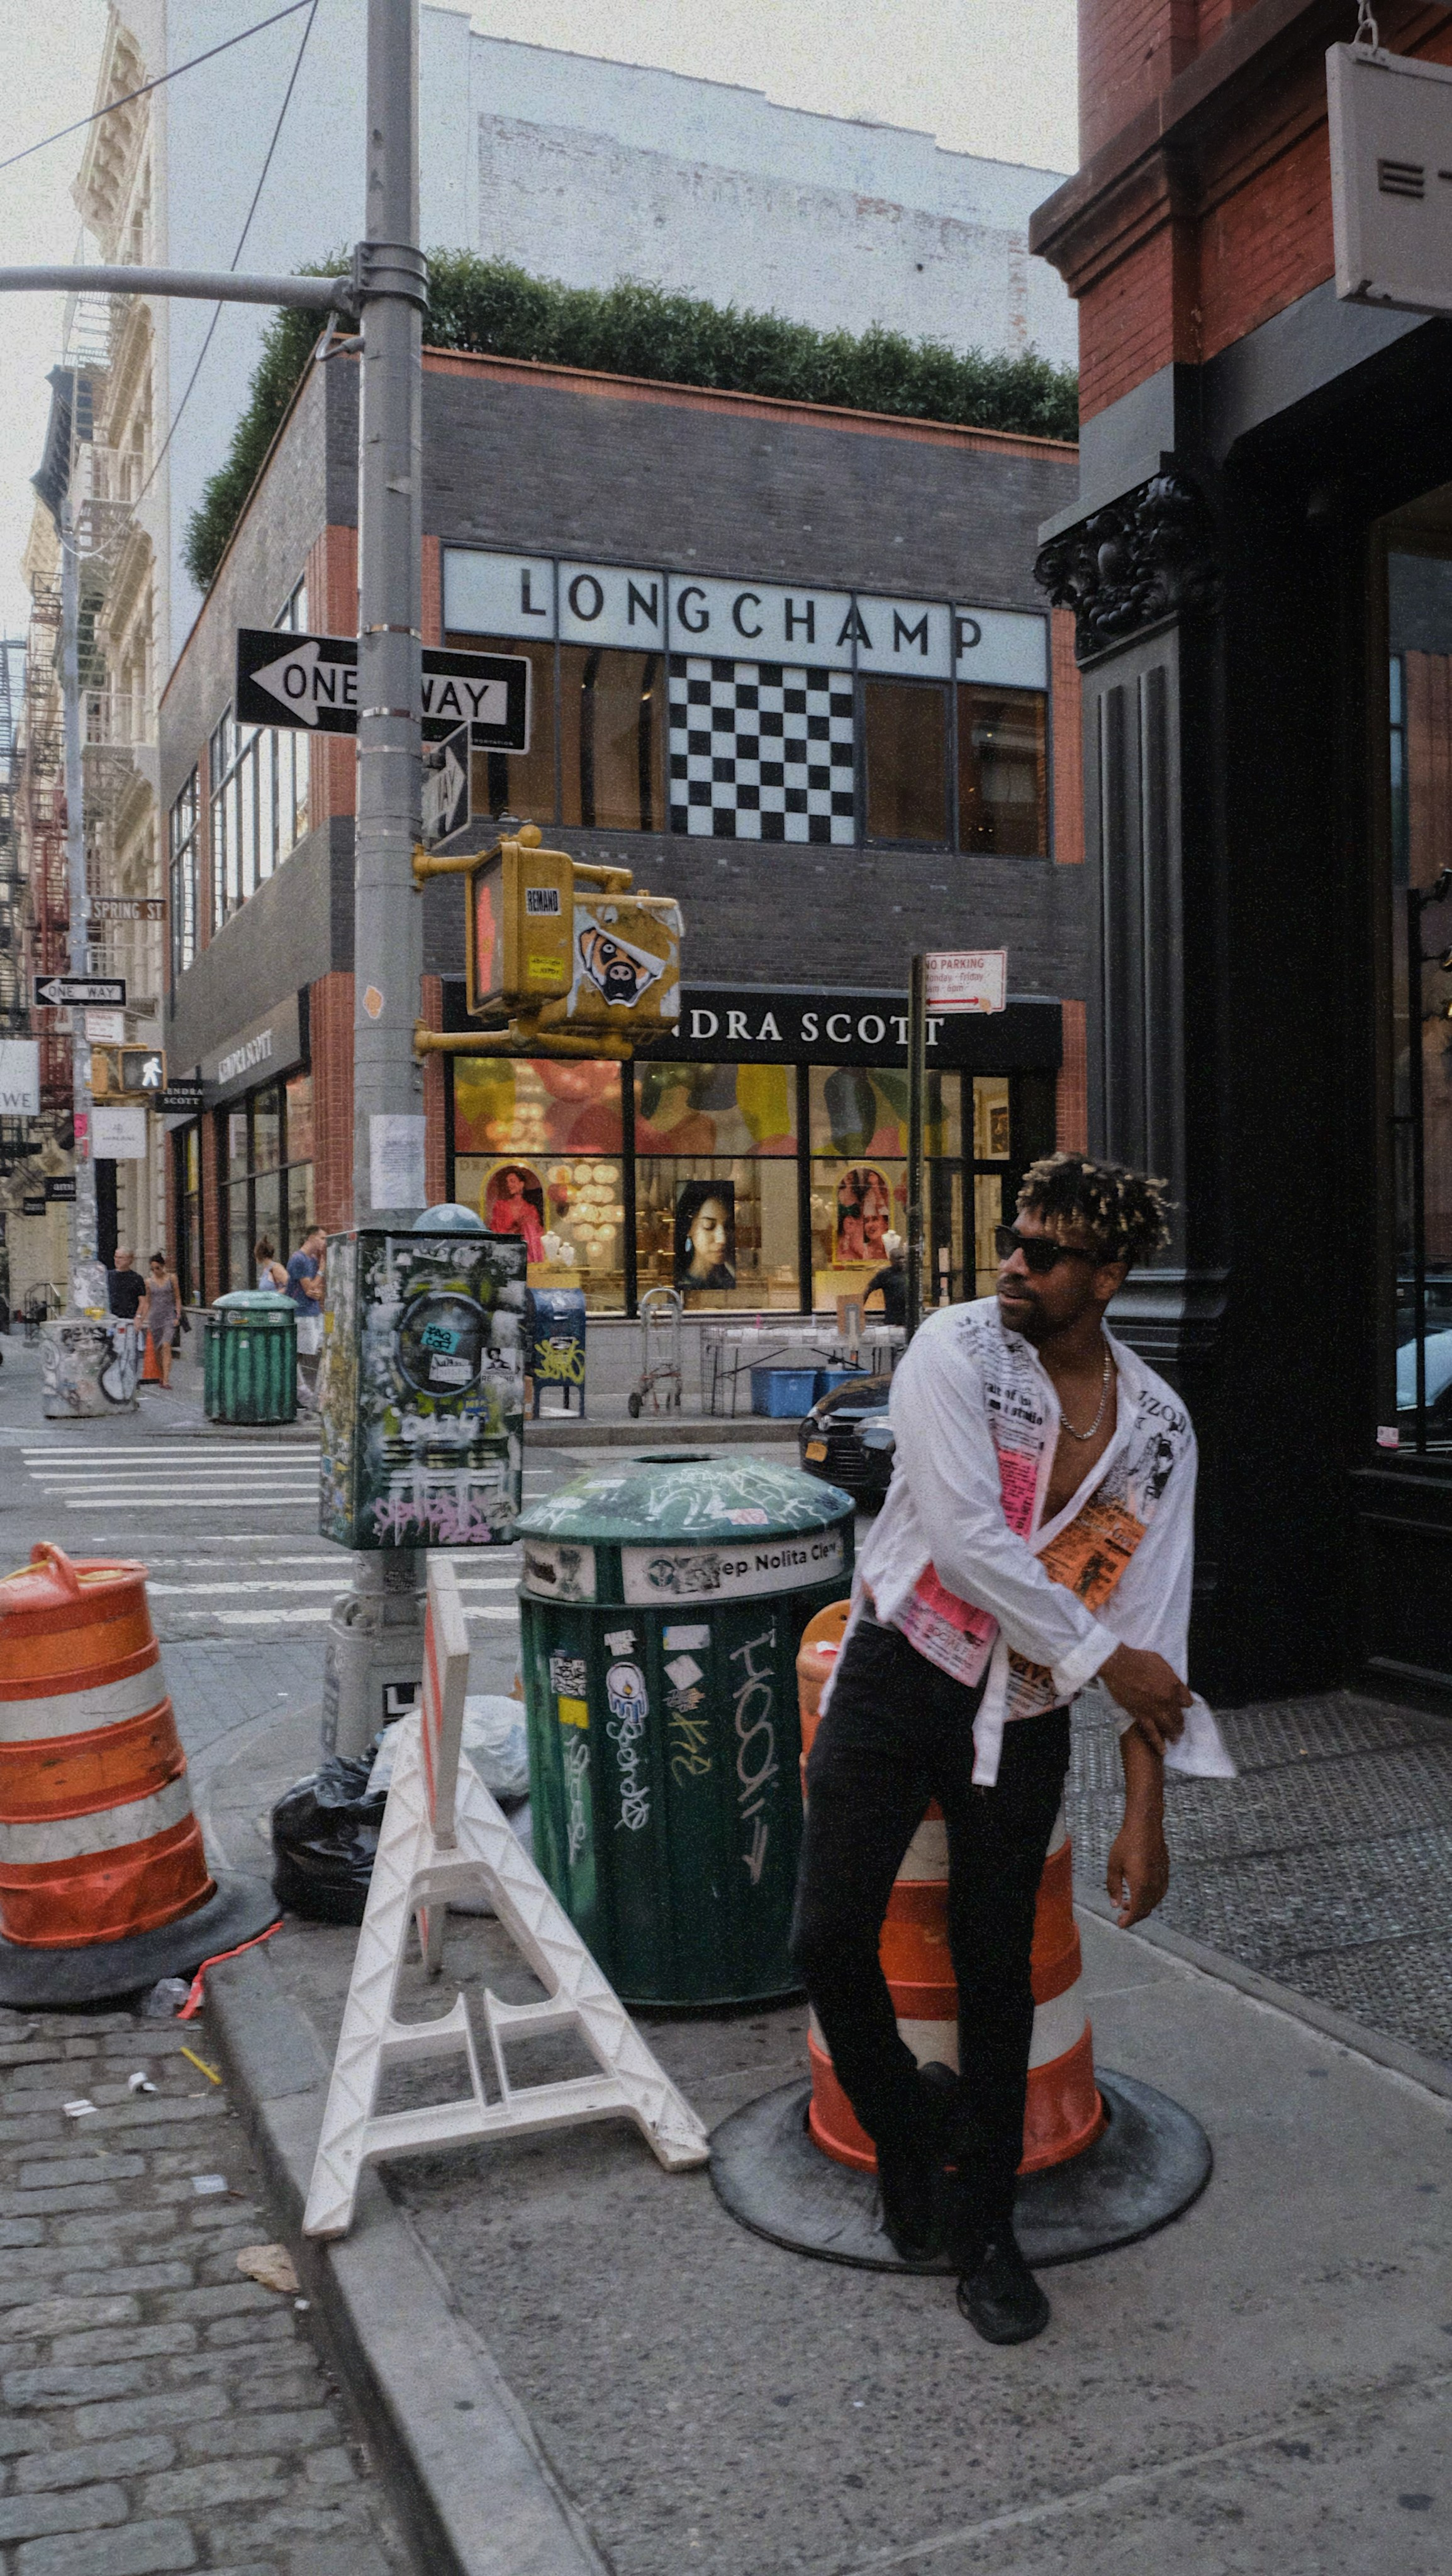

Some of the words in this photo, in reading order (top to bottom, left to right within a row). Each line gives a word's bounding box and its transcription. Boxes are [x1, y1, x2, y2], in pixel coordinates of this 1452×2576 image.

[520, 568, 982, 659] LONGCHAMP
[283, 663, 357, 705] ONE
[94, 901, 140, 919] SPRING
[147, 902, 163, 919] ST
[941, 958, 985, 970] PARKING
[959, 972, 983, 982] Friday
[48, 985, 74, 997] ONE
[87, 986, 115, 997] WAY
[800, 1013, 944, 1046] SCOTT
[756, 1550, 807, 1572] Nolita
